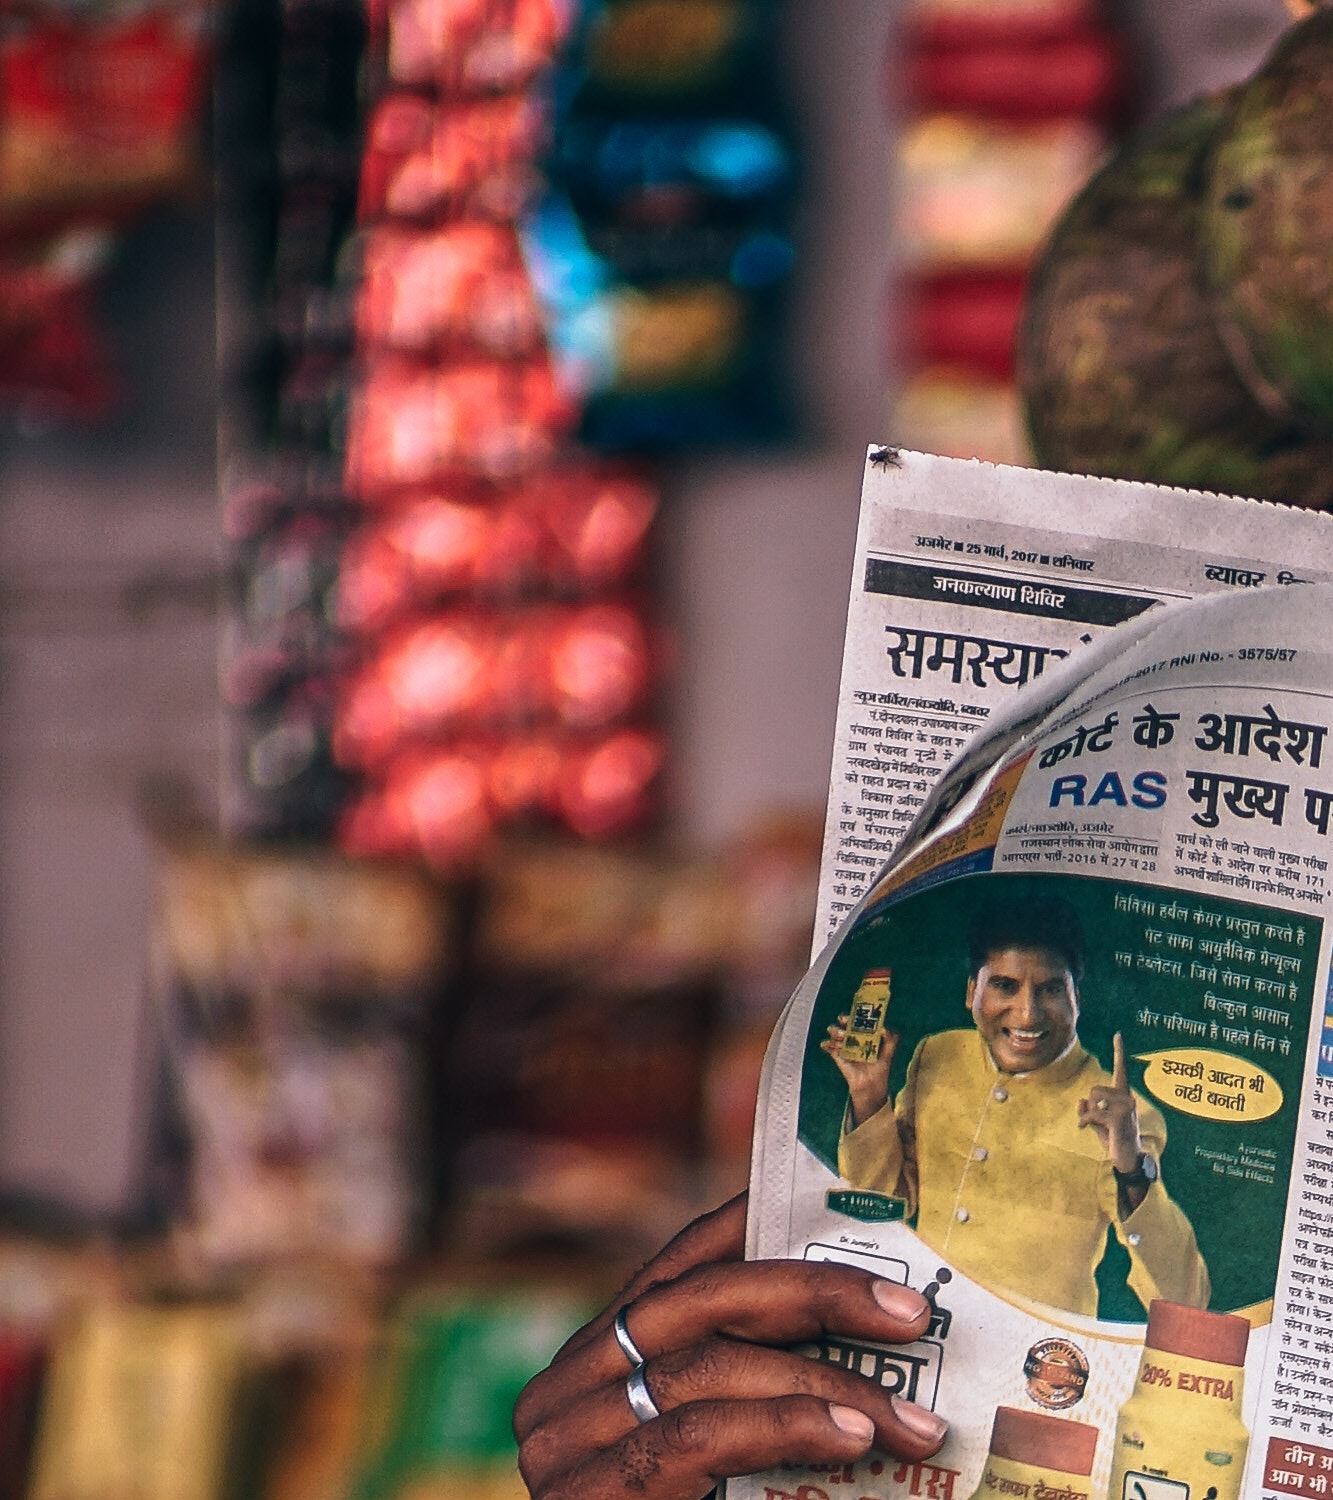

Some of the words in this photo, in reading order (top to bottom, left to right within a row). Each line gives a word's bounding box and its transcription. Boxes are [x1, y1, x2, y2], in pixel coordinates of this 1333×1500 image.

[933, 576, 1017, 602] जनकल्याण
[1020, 585, 1066, 609] शिविर
[1038, 710, 1119, 770] कोर्ट
[1133, 703, 1180, 749] के
[1194, 704, 1328, 768] आदेश
[1049, 770, 1167, 810] RAS
[1186, 769, 1289, 828] मुख्य
